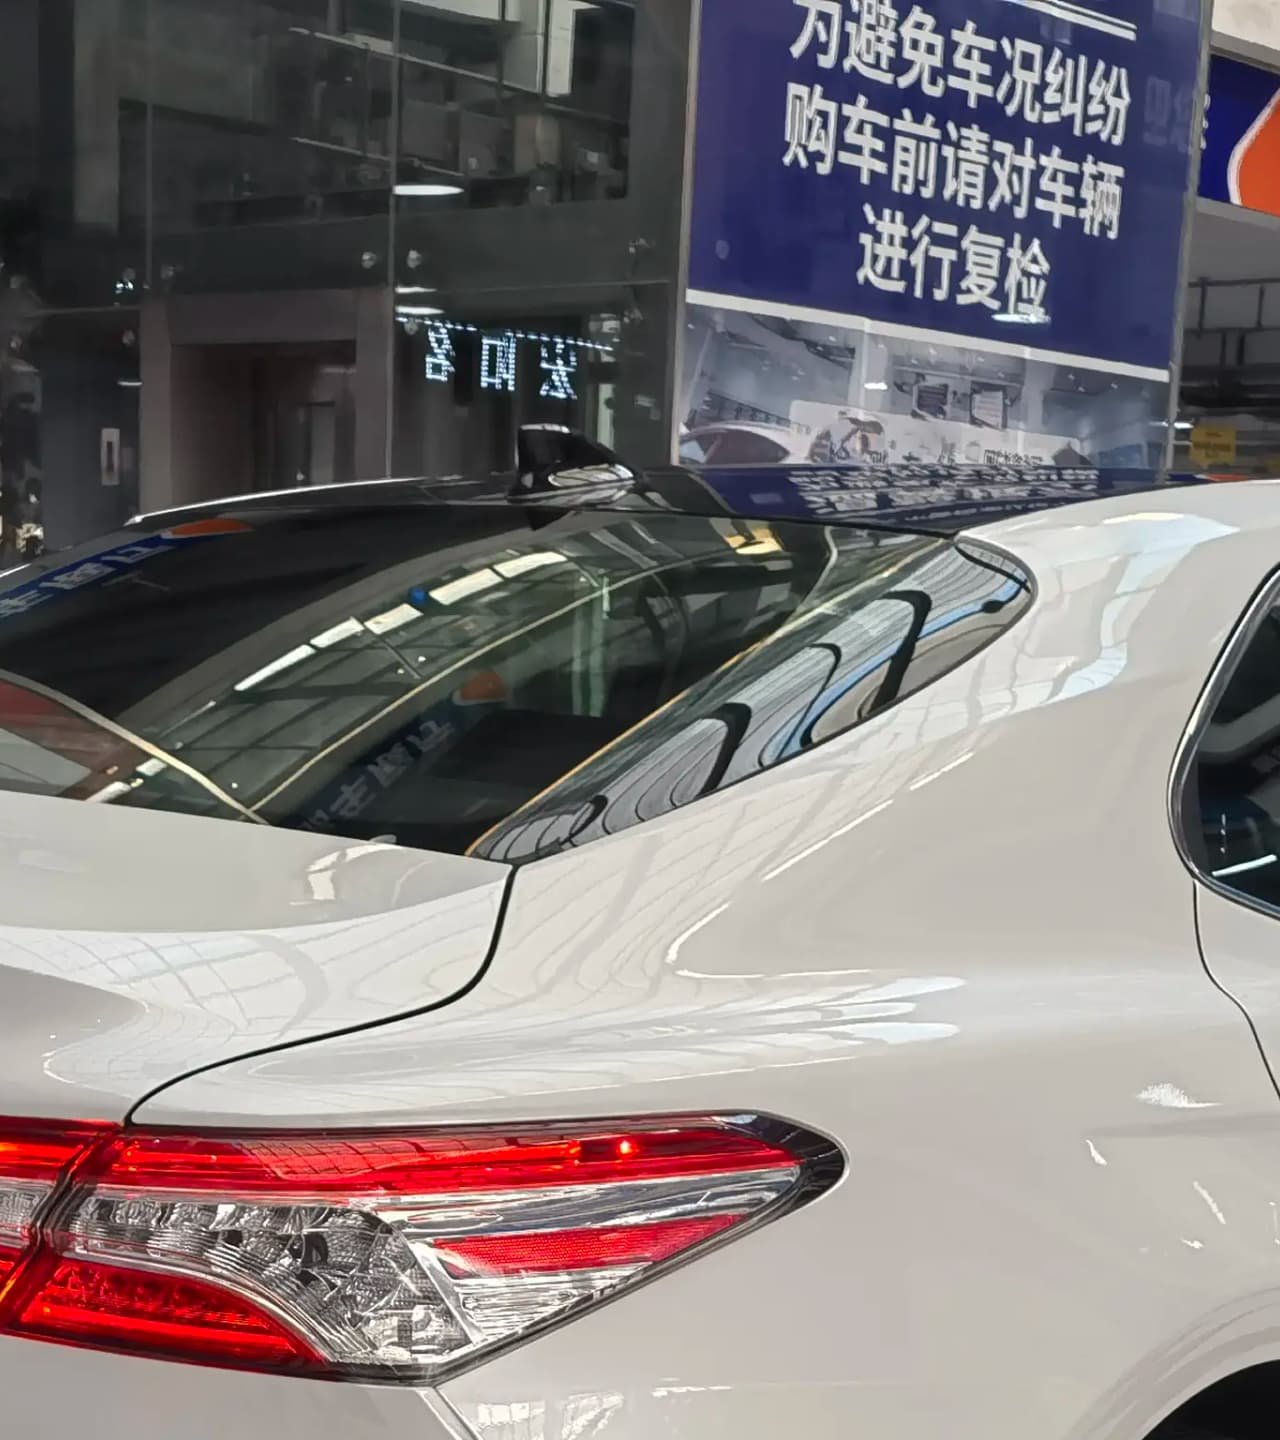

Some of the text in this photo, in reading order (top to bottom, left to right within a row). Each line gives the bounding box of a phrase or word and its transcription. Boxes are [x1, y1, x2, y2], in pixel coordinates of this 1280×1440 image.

[789, 0, 1132, 146] 为避免车况纠纷
[782, 81, 1126, 240] 购车前请对车辆
[856, 202, 1052, 318] 进行复检
